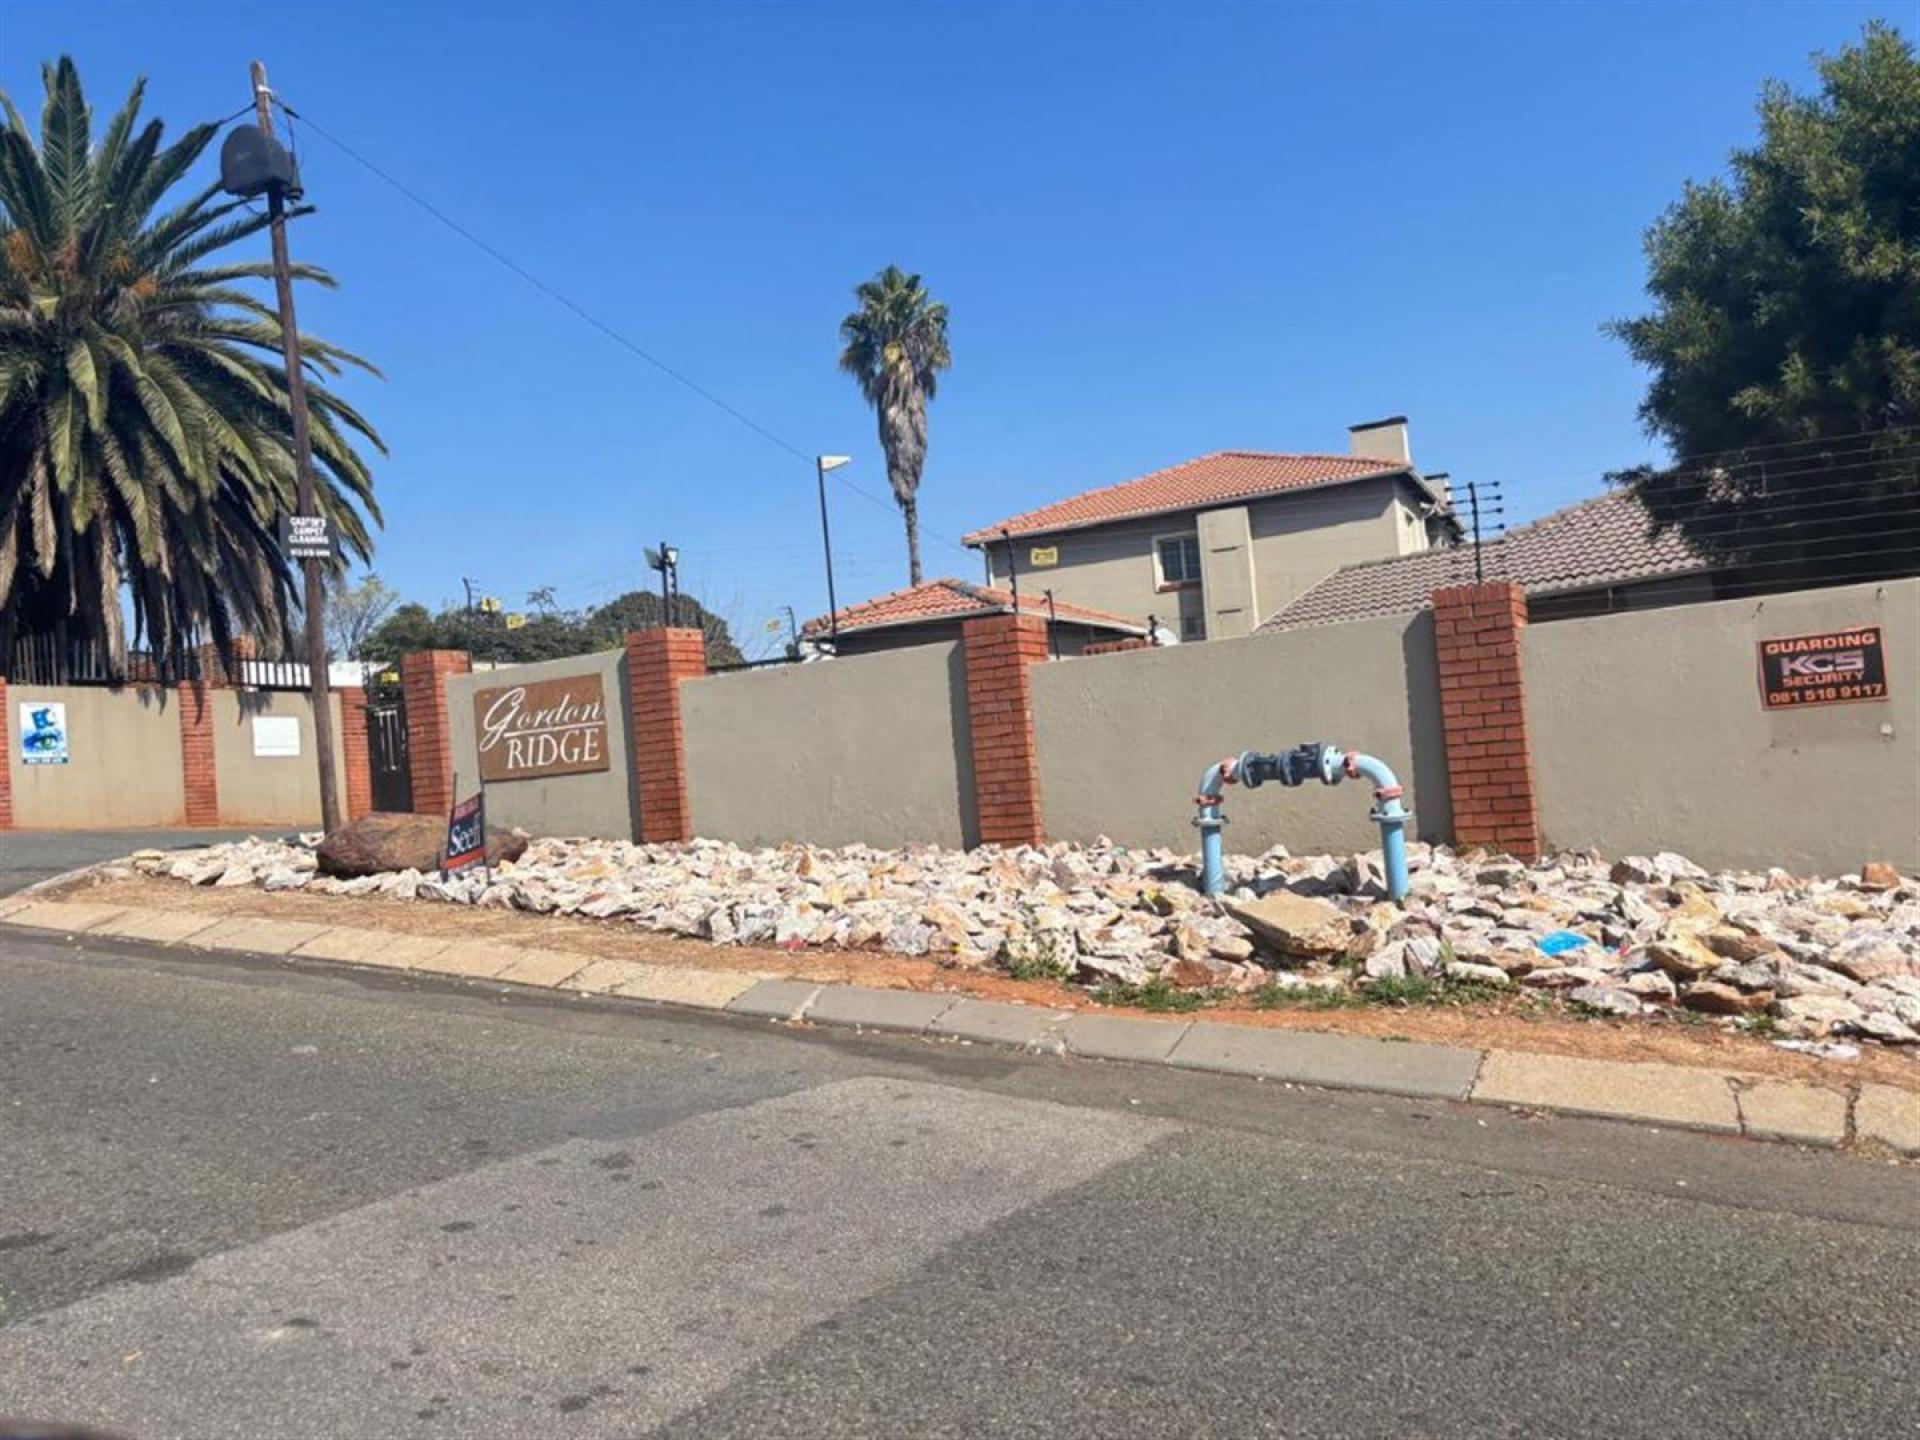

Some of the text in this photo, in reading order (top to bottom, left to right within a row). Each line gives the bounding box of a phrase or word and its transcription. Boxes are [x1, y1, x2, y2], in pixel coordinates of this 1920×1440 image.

[288, 535, 329, 545] CLEANING
[1765, 632, 1876, 656] GUARDING
[1780, 649, 1865, 676] KCS
[1782, 671, 1865, 687] SECURITY
[479, 687, 601, 752] Gordon
[507, 727, 601, 769] RIDGE
